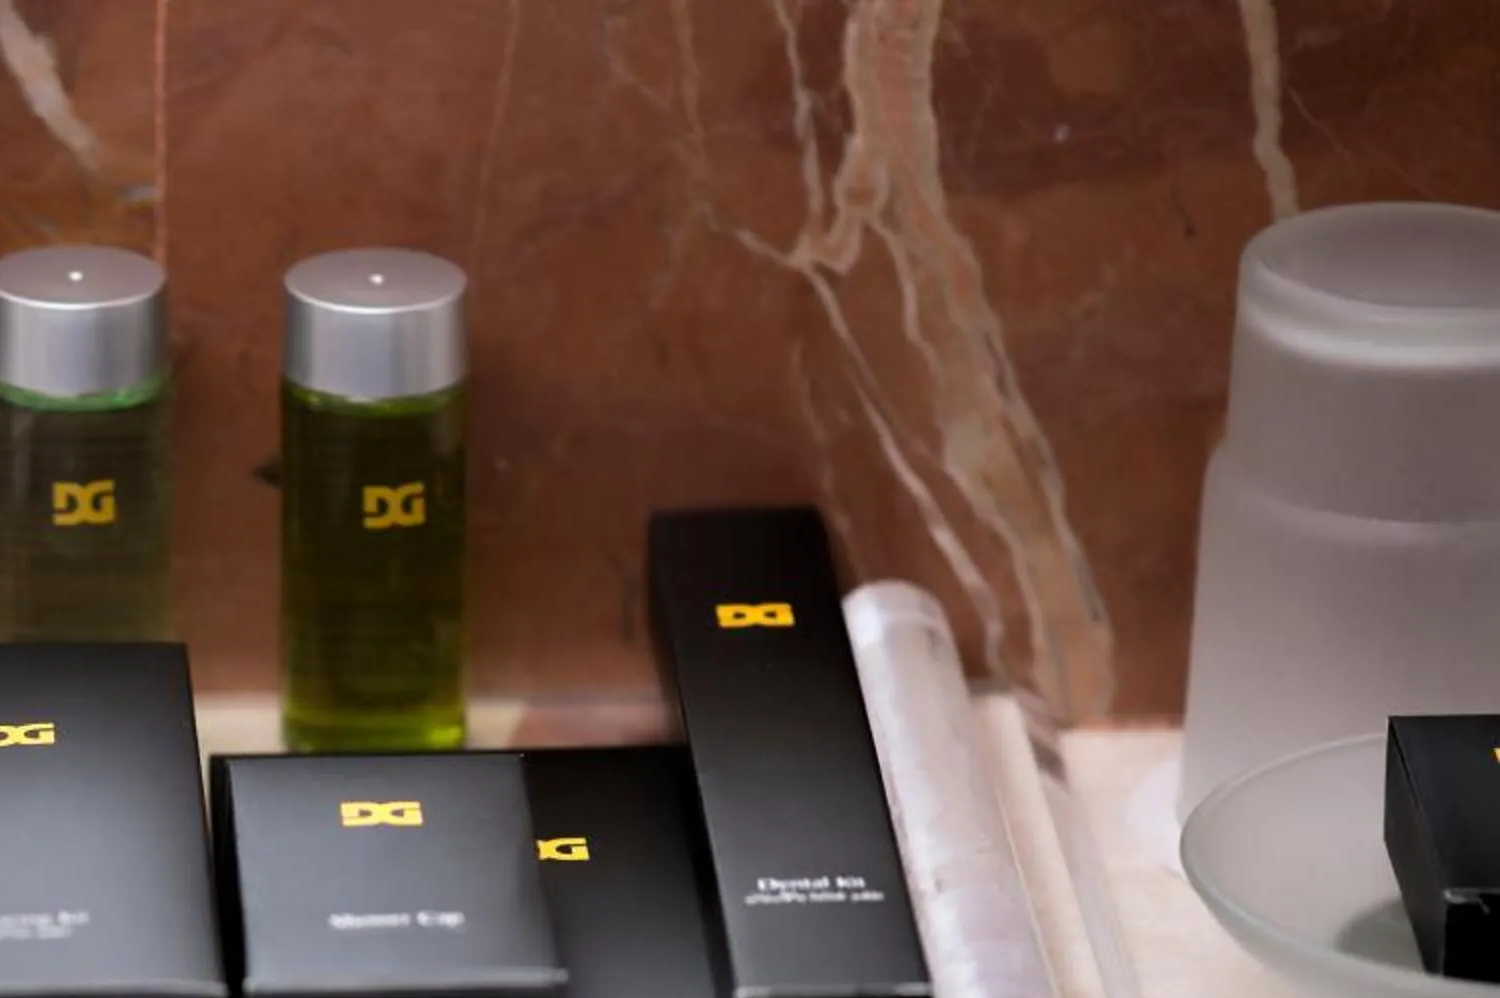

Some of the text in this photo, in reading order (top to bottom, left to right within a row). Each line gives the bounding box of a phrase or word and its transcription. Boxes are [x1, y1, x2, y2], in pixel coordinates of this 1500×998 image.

[52, 480, 116, 526] DG
[363, 482, 426, 529] DG
[340, 801, 423, 827] DG
